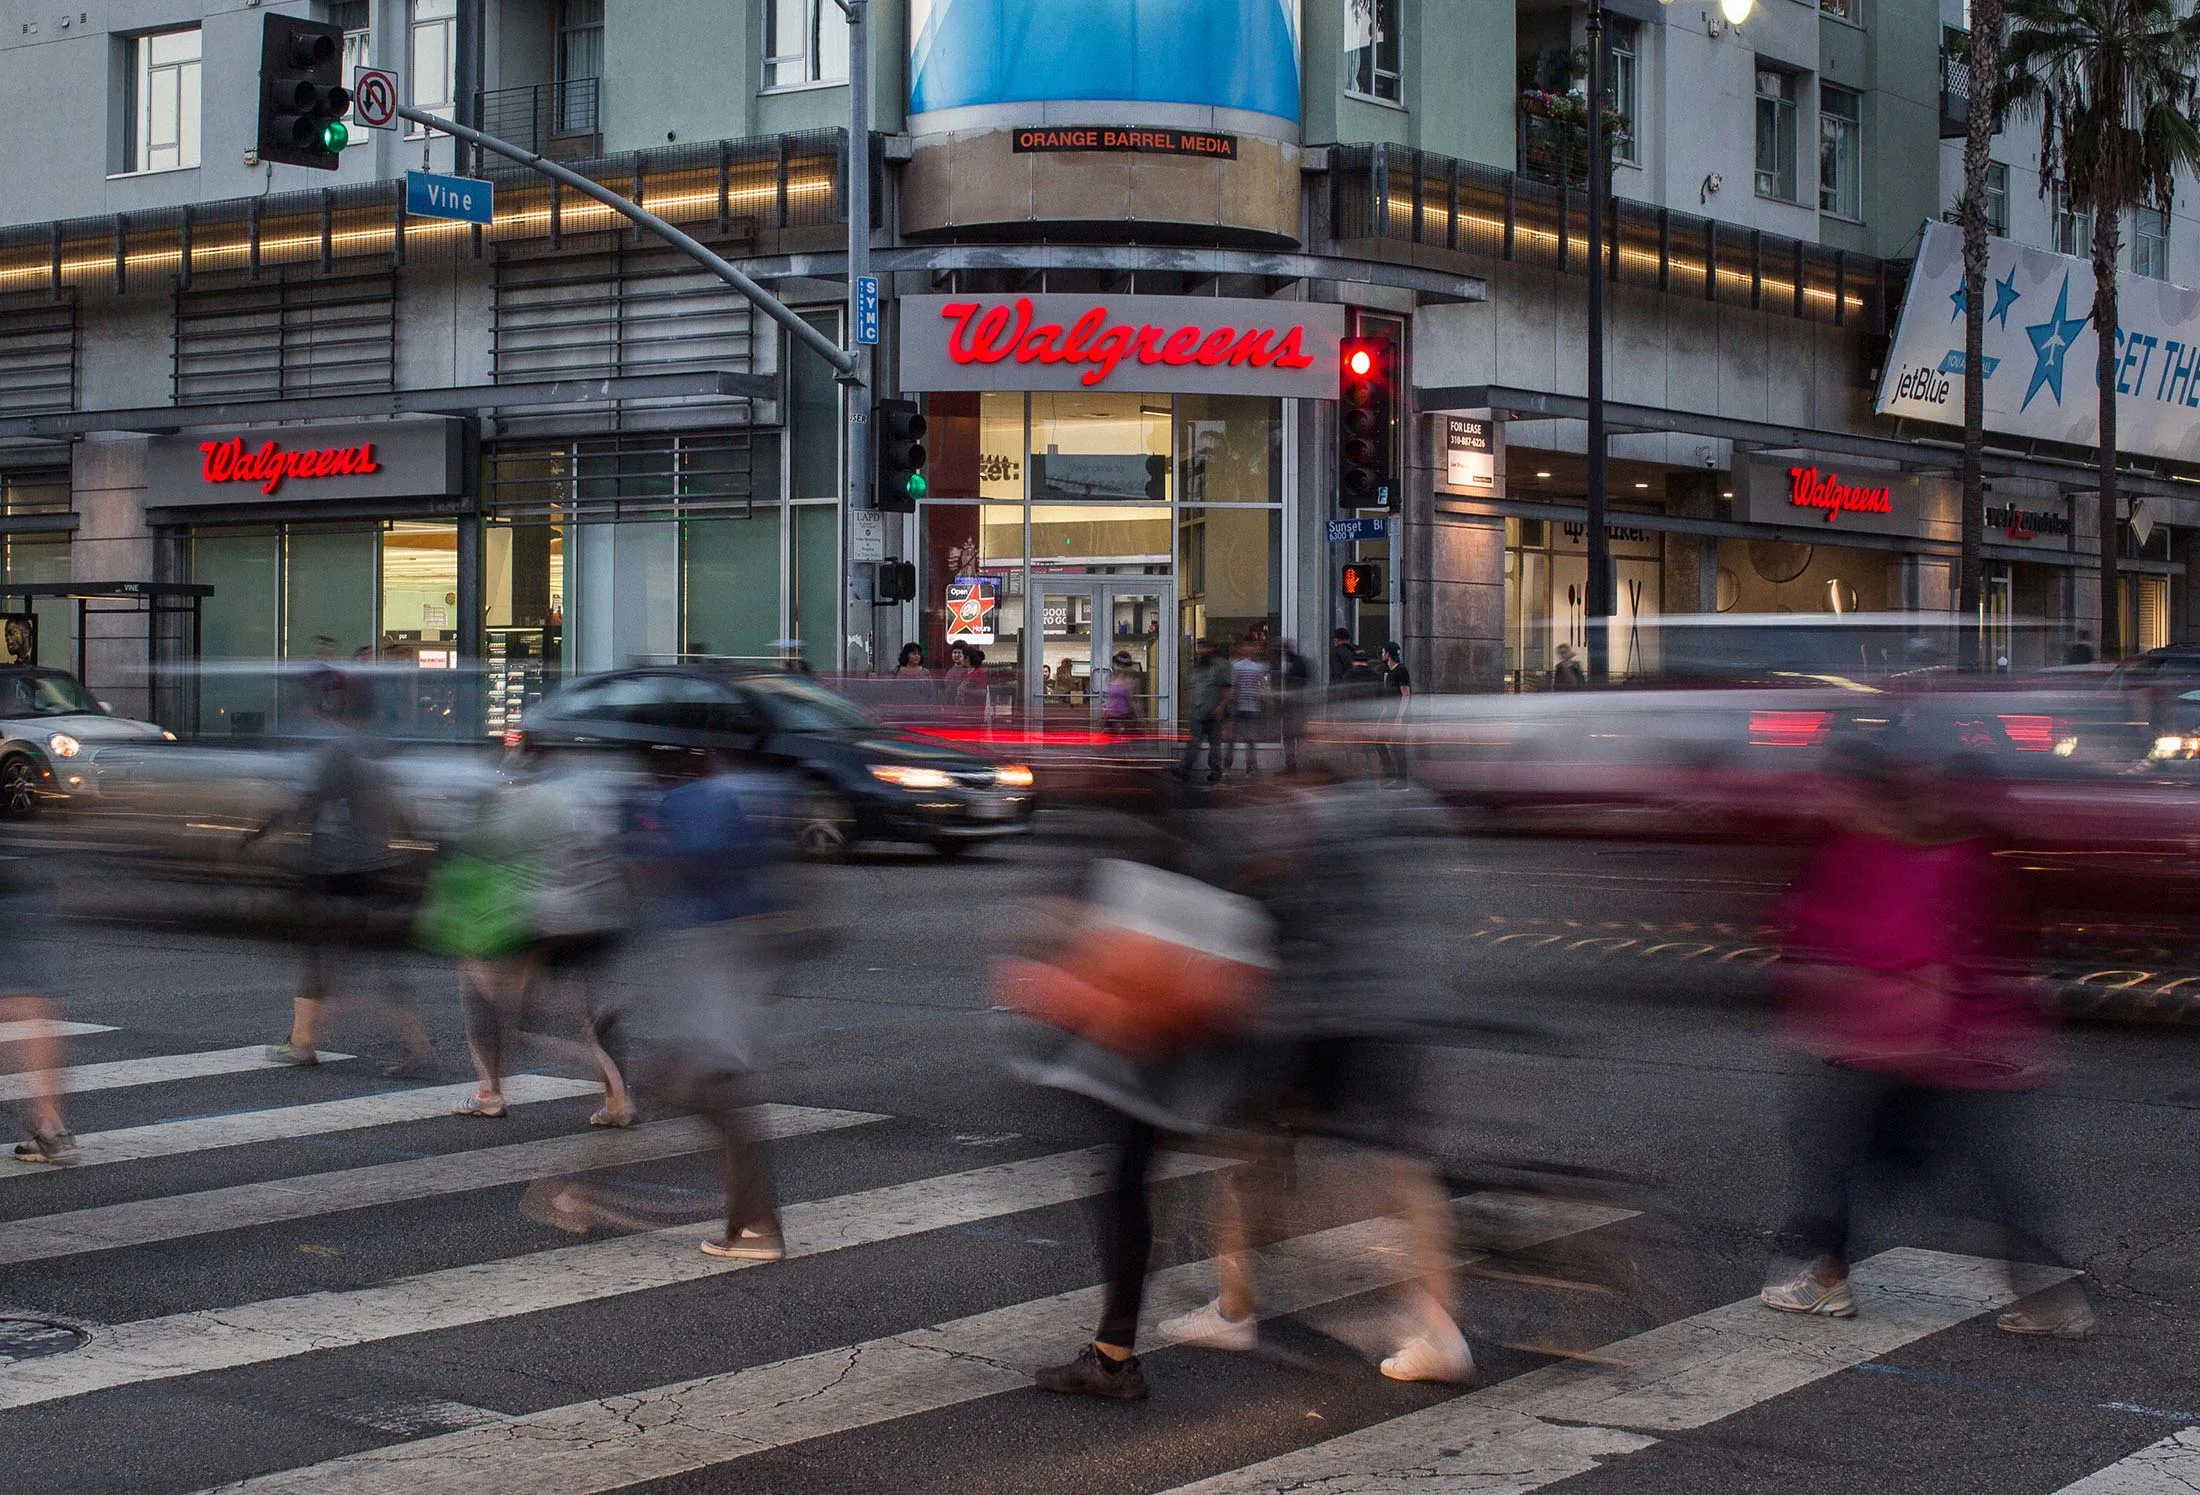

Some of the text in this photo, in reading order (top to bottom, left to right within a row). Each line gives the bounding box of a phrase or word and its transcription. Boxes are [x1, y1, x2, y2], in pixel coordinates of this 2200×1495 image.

[1020, 131, 1231, 153] ORANGE BARREL MEDIA
[427, 183, 472, 211] Vine
[866, 282, 876, 340] SYNC
[940, 296, 1314, 386] Walgreens
[1891, 364, 1950, 404] jetBlue
[1450, 421, 1482, 435] FOR LEASE
[199, 436, 377, 495] Walgreens
[1791, 465, 1893, 522] Walgreens
[856, 512, 880, 521] LAPD
[1329, 520, 1383, 532] Sunset Bl
[1329, 532, 1347, 540] 6300
[124, 583, 139, 591] VINE
[950, 588, 968, 596] Open
[963, 602, 978, 617] 24
